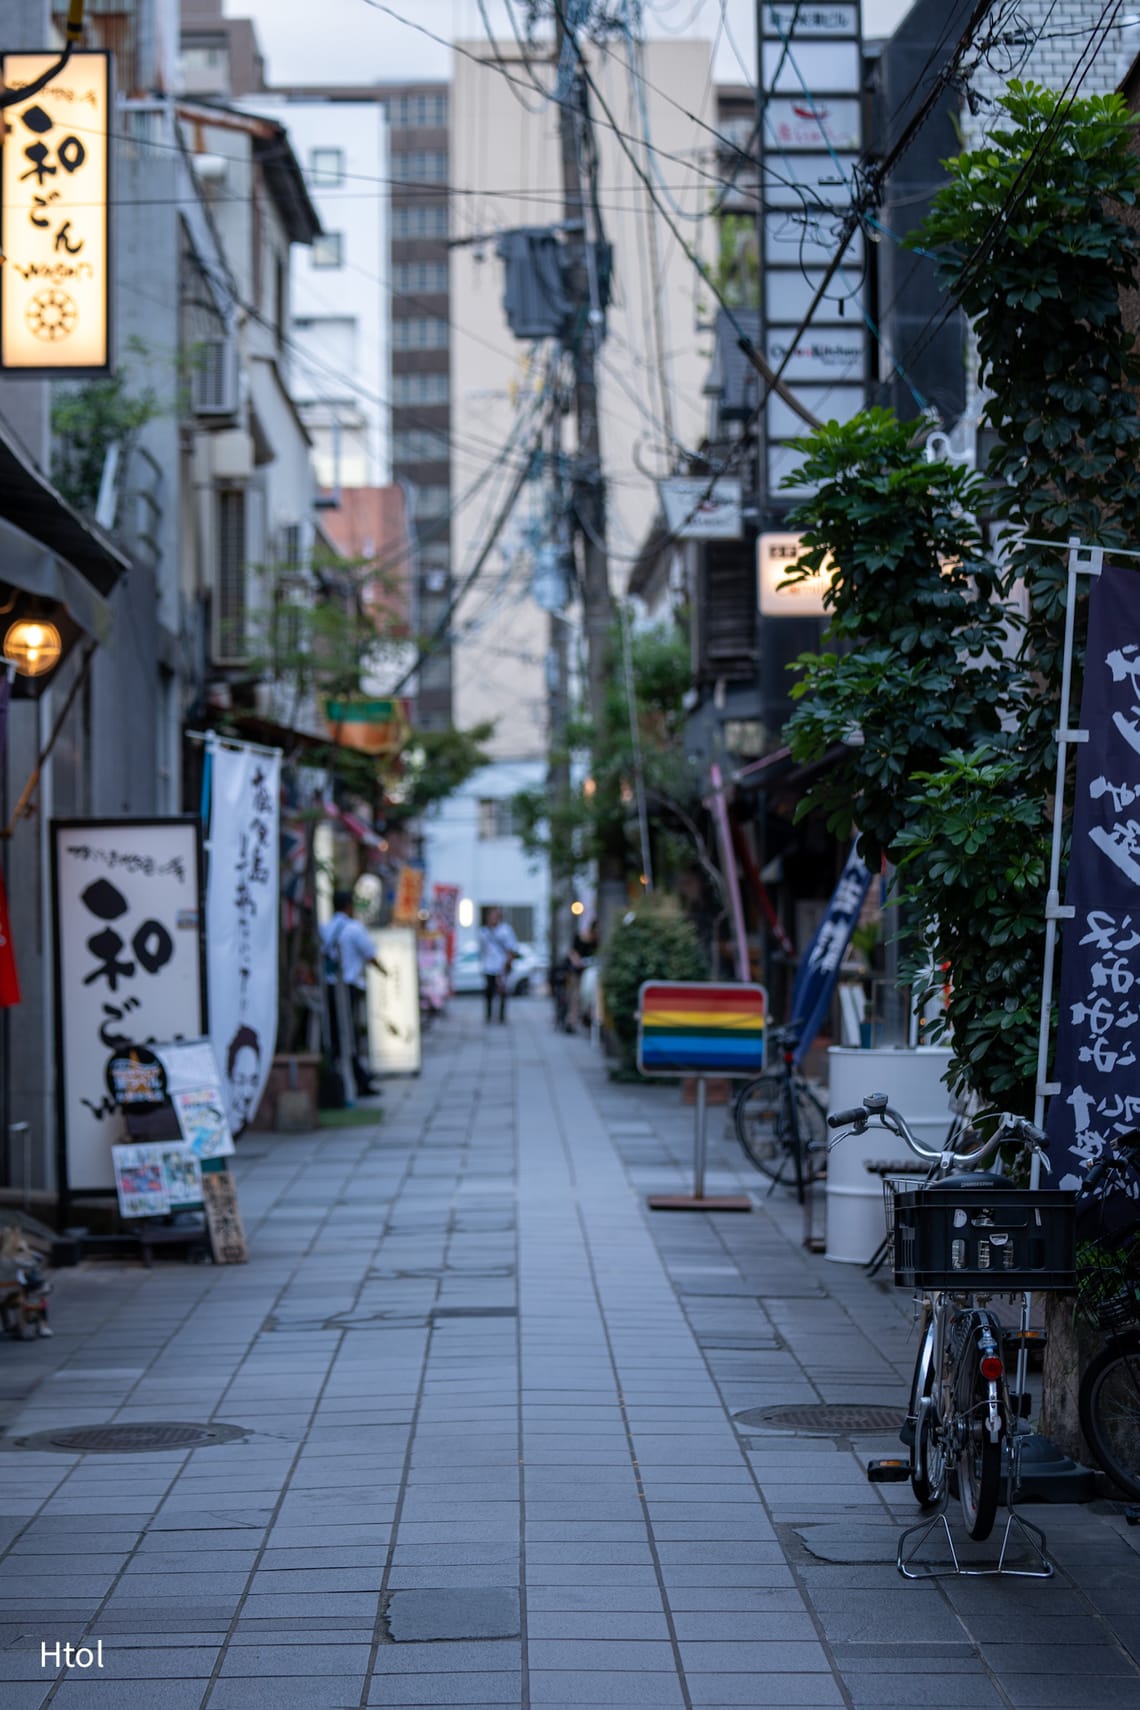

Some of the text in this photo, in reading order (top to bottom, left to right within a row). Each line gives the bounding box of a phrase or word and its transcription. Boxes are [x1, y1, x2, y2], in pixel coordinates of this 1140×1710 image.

[20, 105, 86, 254] 和ごん
[80, 875, 184, 1043] 和ご
